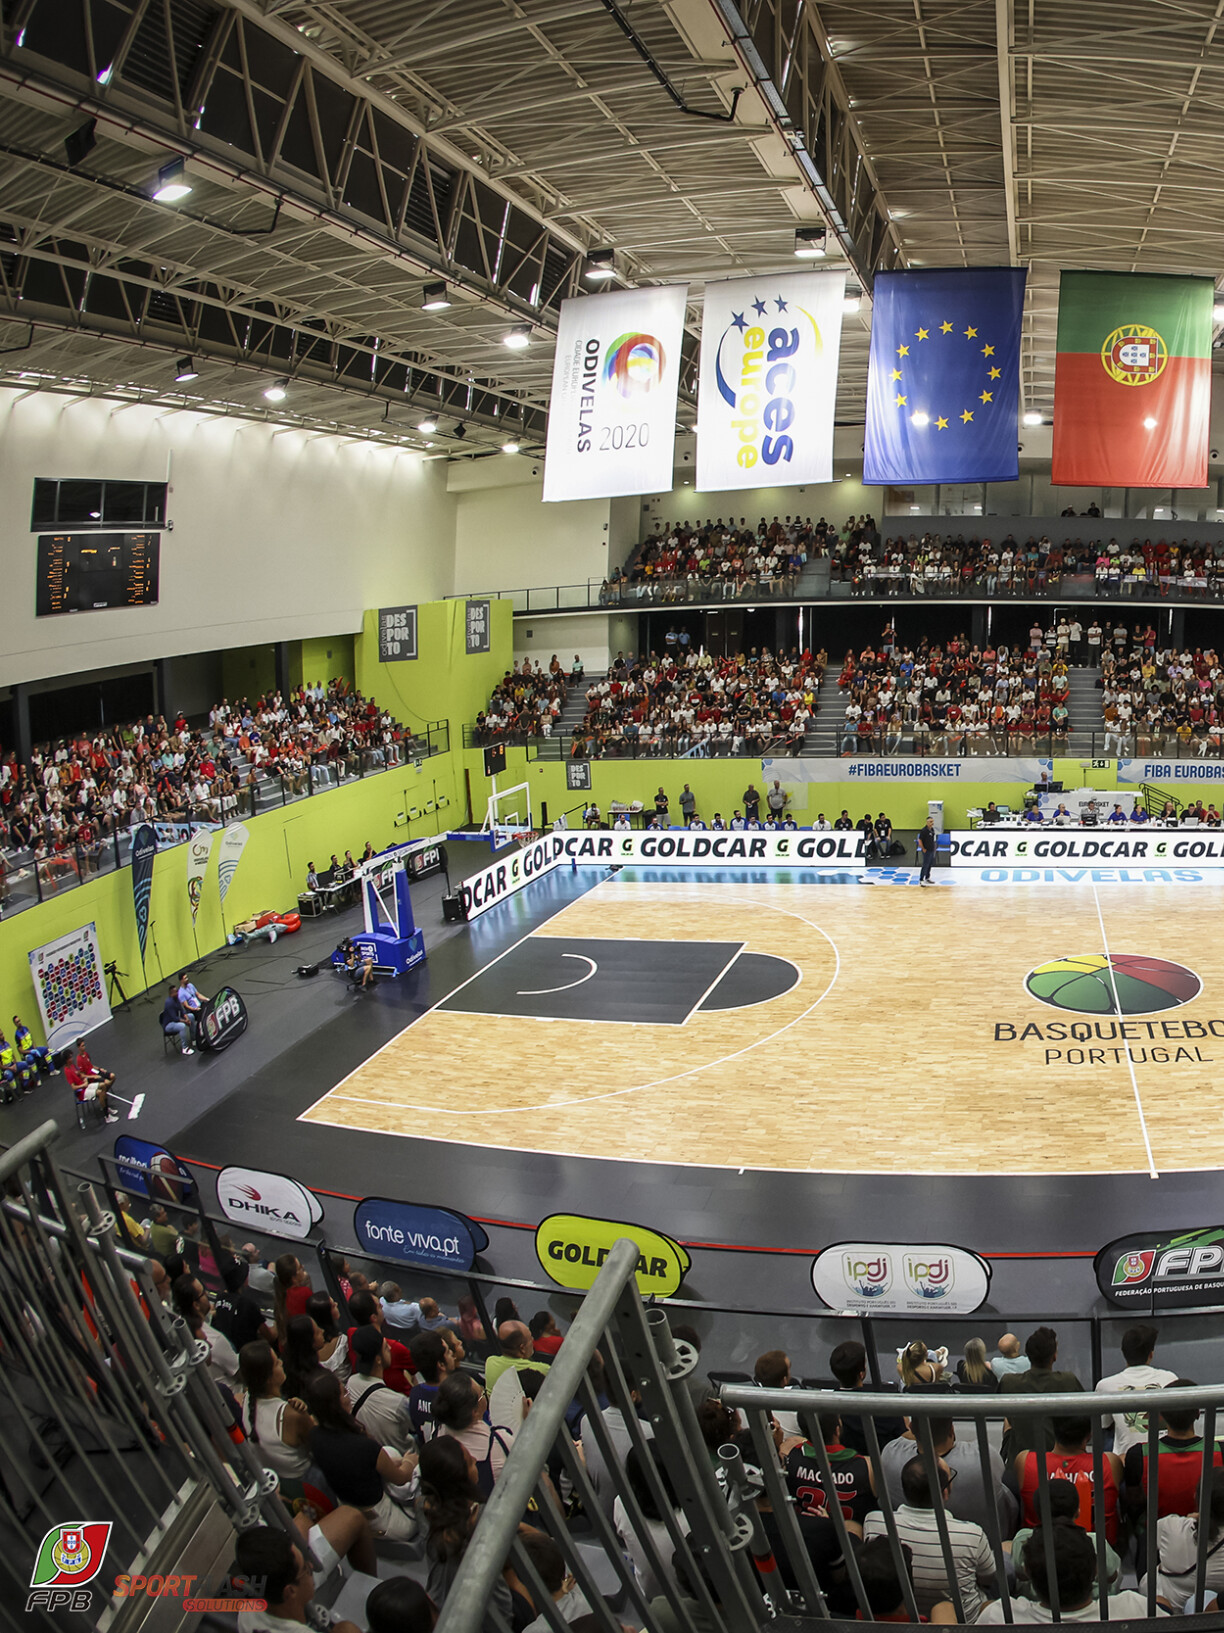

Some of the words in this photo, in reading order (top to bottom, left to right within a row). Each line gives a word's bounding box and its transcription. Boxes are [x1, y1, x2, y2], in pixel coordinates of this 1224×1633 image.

[577, 338, 600, 453] ODIVELAS
[731, 326, 766, 469] europe
[761, 327, 800, 466] aces
[599, 422, 650, 452] 2020
[386, 613, 406, 628] DES
[471, 607, 483, 620] DES
[386, 628, 409, 641] POR
[471, 620, 485, 633] POR
[387, 642, 400, 655] TO
[471, 634, 480, 647] TO
[848, 763, 961, 777] #FIBAEUROBASKET
[1144, 765, 1170, 778] FIBA
[622, 839, 632, 851] G
[640, 838, 768, 857] GOLDCAR
[777, 839, 788, 851] G
[1017, 842, 1027, 852] G
[1034, 841, 1148, 857] GOLDCAR
[1156, 842, 1167, 853] G
[980, 869, 1204, 882] ODIVELAS
[216, 994, 240, 1030] FPB
[1044, 1047, 1213, 1065] PORTUGAL
[228, 1197, 301, 1223] DHIKA
[365, 1220, 405, 1244] fonte
[407, 1230, 460, 1257] viva.pt
[847, 1257, 888, 1283] ipdj
[908, 1258, 949, 1284] ipdj
[1115, 1288, 1152, 1297] FEDERAÇÃO
[1153, 1284, 1193, 1294] PORTUGUESA
[797, 1466, 854, 1484] MACADO
